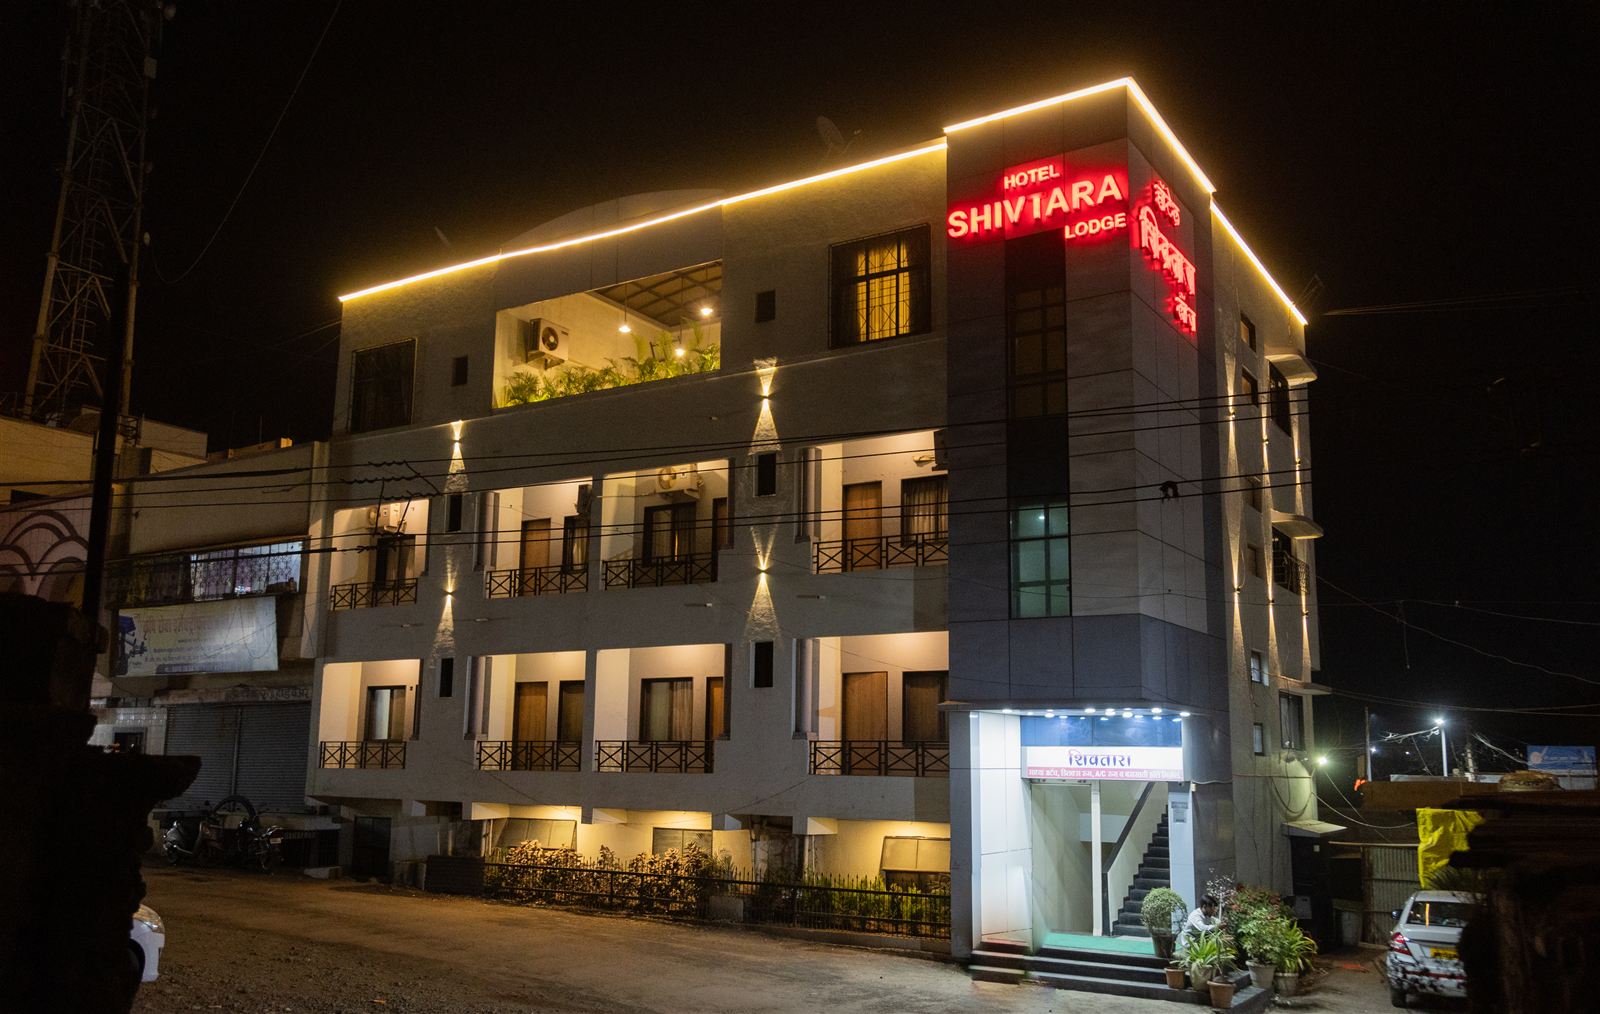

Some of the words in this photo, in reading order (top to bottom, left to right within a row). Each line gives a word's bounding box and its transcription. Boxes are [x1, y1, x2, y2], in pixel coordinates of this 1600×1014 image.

[1003, 164, 1060, 190] HOTEL
[947, 175, 1123, 239] SHIVTARA
[1065, 212, 1127, 239] LODGE
[1068, 749, 1131, 767] शिवतारा
[1095, 769, 1106, 777] A/C
